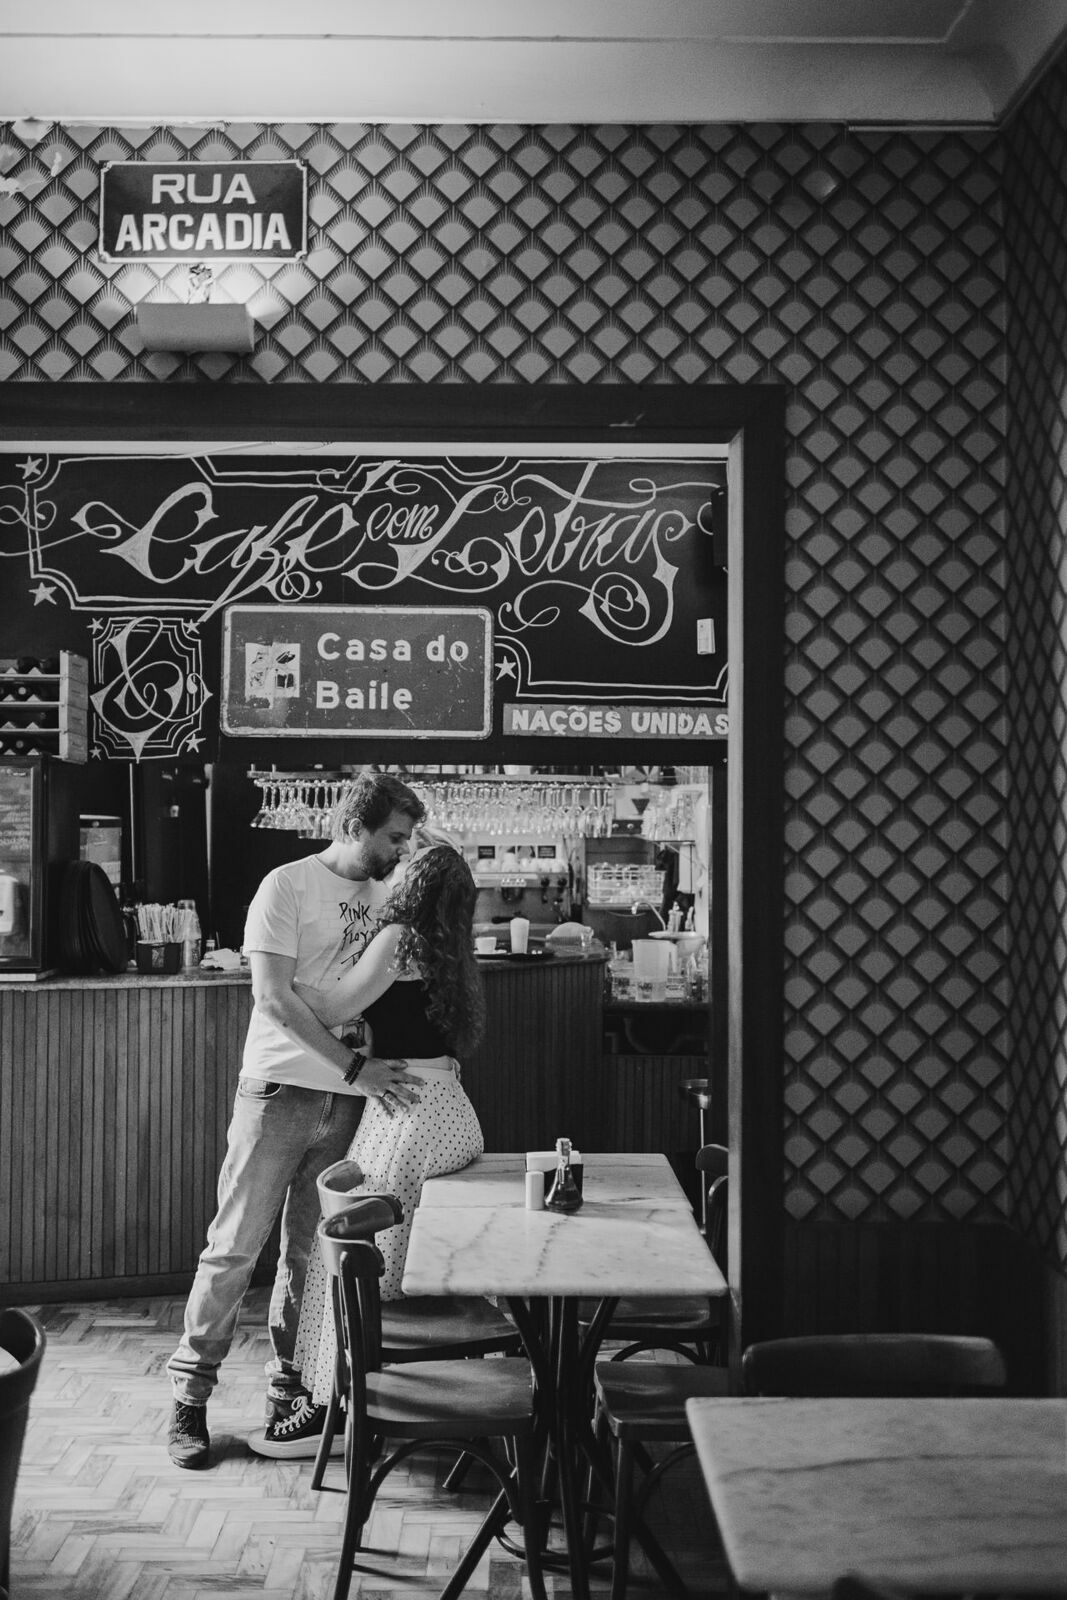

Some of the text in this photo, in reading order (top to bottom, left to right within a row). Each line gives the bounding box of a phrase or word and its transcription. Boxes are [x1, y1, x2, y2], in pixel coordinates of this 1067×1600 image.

[152, 173, 256, 204] RUA
[115, 213, 292, 251] ARCADIA
[366, 502, 439, 540] com
[341, 461, 700, 646] Letras
[317, 632, 469, 662] Casa do
[316, 680, 413, 710] Baile
[511, 705, 729, 736] NAÇÕES UNIDAS
[339, 901, 372, 927] PINK
